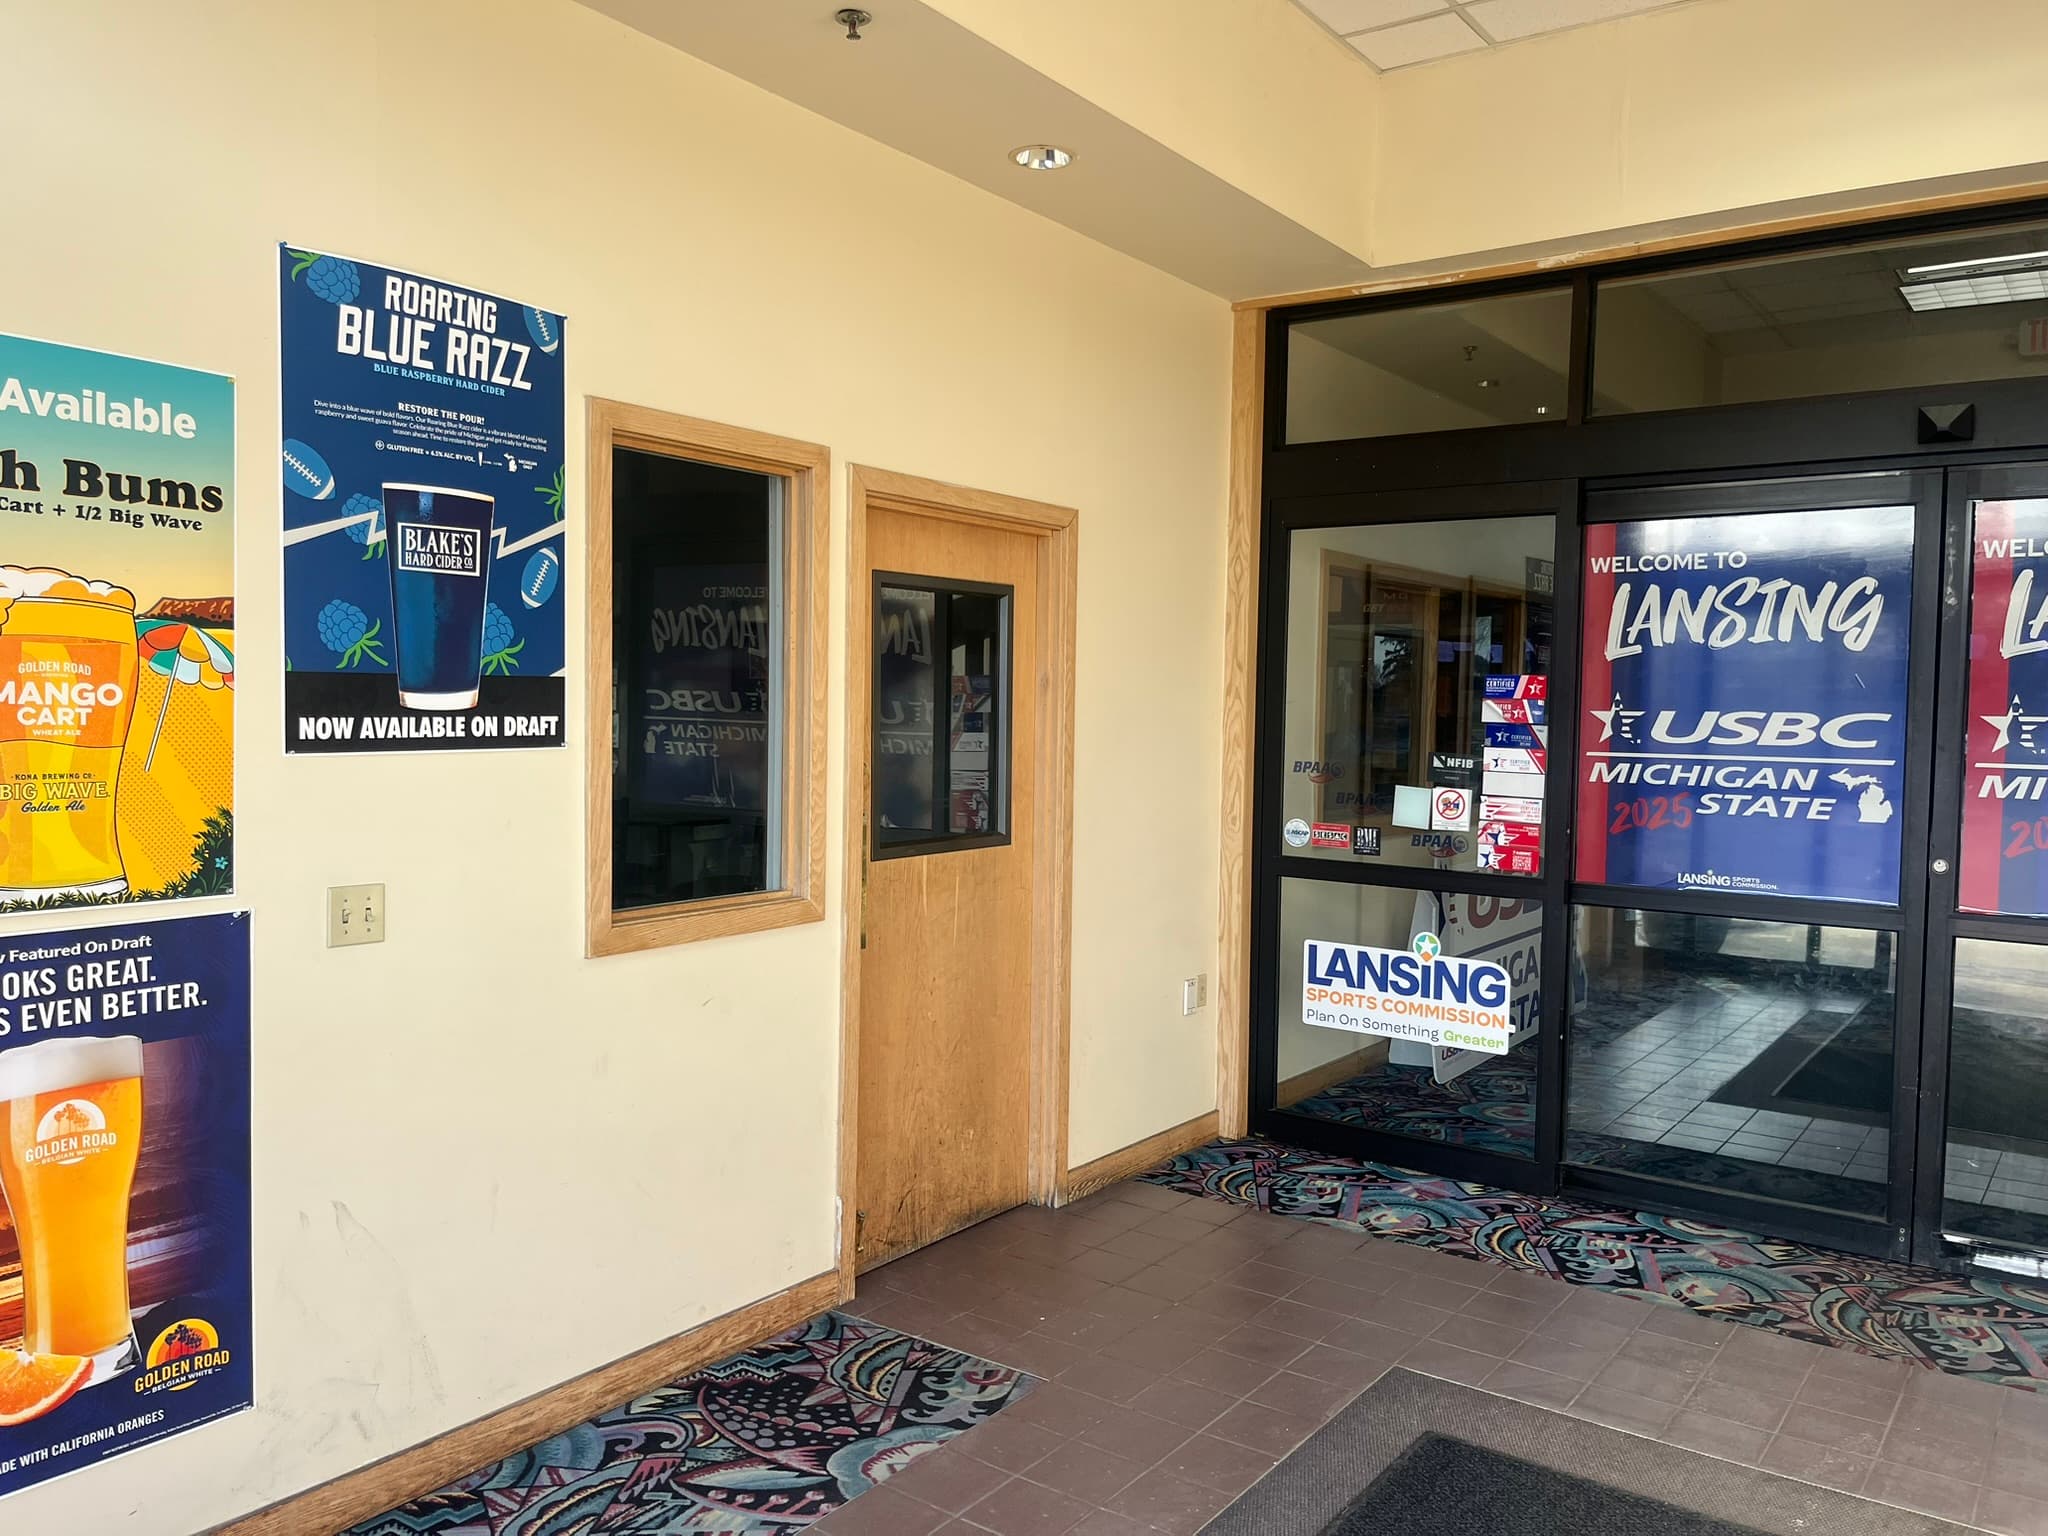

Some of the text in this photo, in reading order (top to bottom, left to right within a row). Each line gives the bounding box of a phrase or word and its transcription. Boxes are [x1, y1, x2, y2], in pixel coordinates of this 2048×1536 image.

[384, 275, 497, 334] ROARING
[337, 304, 532, 391] BLUE RAZZ
[373, 363, 505, 397] BLUE RASPBERRY HARD CIDER
[0, 378, 197, 439] Available
[315, 409, 344, 419] raspberry
[346, 404, 359, 412] blue
[398, 402, 485, 425] RESTORE THE POUR!
[387, 443, 409, 452] GLUTEN
[62, 459, 223, 513] Bums
[0, 497, 43, 514] Cart
[75, 505, 102, 521] 1/2
[109, 509, 144, 528] Big
[150, 513, 203, 531] Wave
[405, 528, 473, 557] BLAKE'S
[405, 552, 433, 567] HARD
[435, 556, 463, 570] CIDER
[1591, 551, 1748, 574] WELCOME TO
[1605, 577, 1884, 662] LANSING
[18, 661, 92, 675] GOLDEN ROAD
[17, 706, 93, 726] CART
[299, 716, 559, 740] NOW AVAILABLE ON DRAFT
[1650, 710, 1892, 749] USBC
[42, 772, 80, 780] BREWING
[1293, 761, 1330, 774] BPAA
[1447, 757, 1474, 769] NFIB
[1588, 762, 1820, 791] MICHIGAN
[0, 783, 38, 801] BIG
[21, 800, 86, 813] Golden Ale
[1609, 792, 1837, 835] 2025 STATE
[1356, 828, 1378, 847] BMI
[1411, 834, 1452, 848] BPAA
[9, 943, 81, 962] Featured
[85, 941, 108, 954] On
[112, 935, 152, 951] Draft
[2, 956, 157, 1001] OKS GREAT.
[21, 996, 91, 1033] EVEN
[103, 982, 208, 1020] BETTER.
[1306, 988, 1377, 1010] SPORTS
[1382, 998, 1505, 1030] COMMISSION
[1306, 1009, 1505, 1049] Plan On Something Greater
[25, 1132, 117, 1163] GOLDEN ROAD
[134, 1350, 230, 1393] GOLDEN ROAD
[152, 1367, 213, 1393] BELGIAN WHITE
[19, 1447, 49, 1467] WITH
[51, 1427, 115, 1457] CALIFORNIA
[117, 1409, 165, 1434] ORANGES
